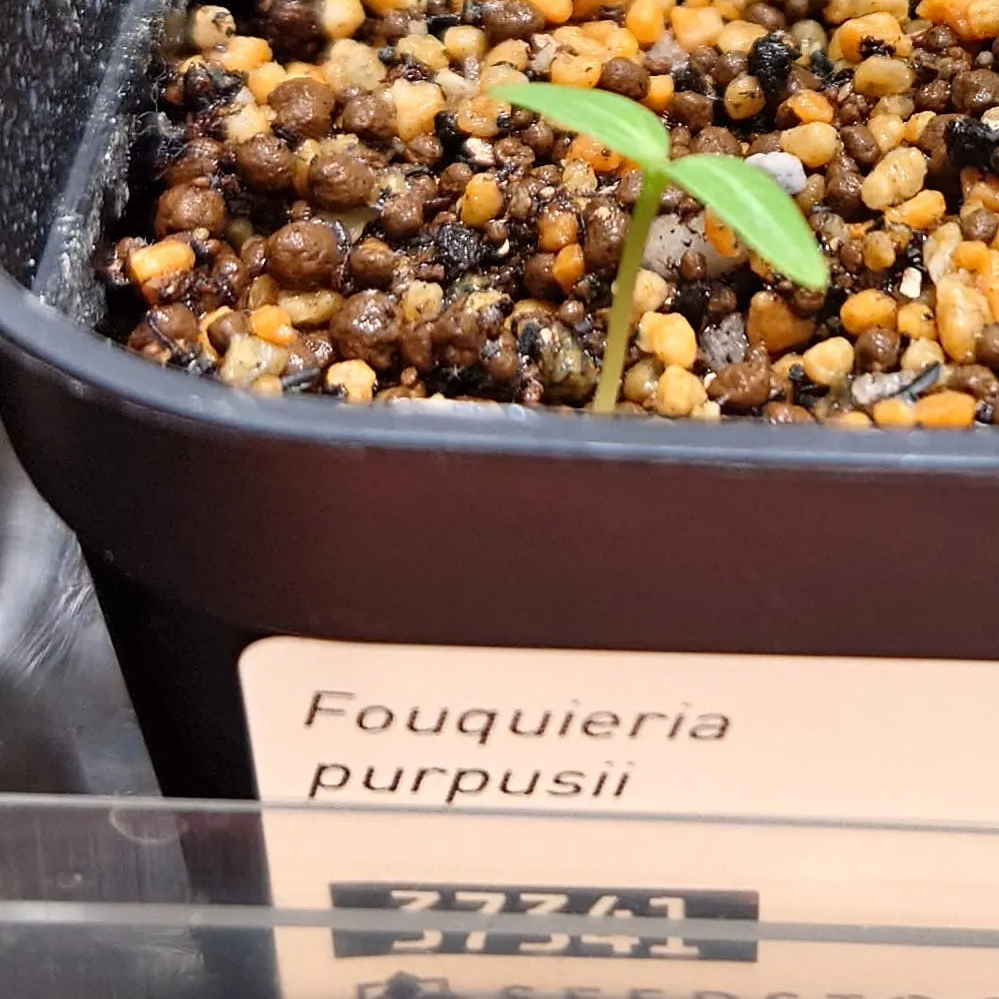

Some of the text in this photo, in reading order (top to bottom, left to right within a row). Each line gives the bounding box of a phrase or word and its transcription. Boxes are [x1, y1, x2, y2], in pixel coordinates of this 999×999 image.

[304, 690, 732, 746] Fouquieria
[307, 759, 635, 803] purpusii
[390, 889, 701, 954] 37341
